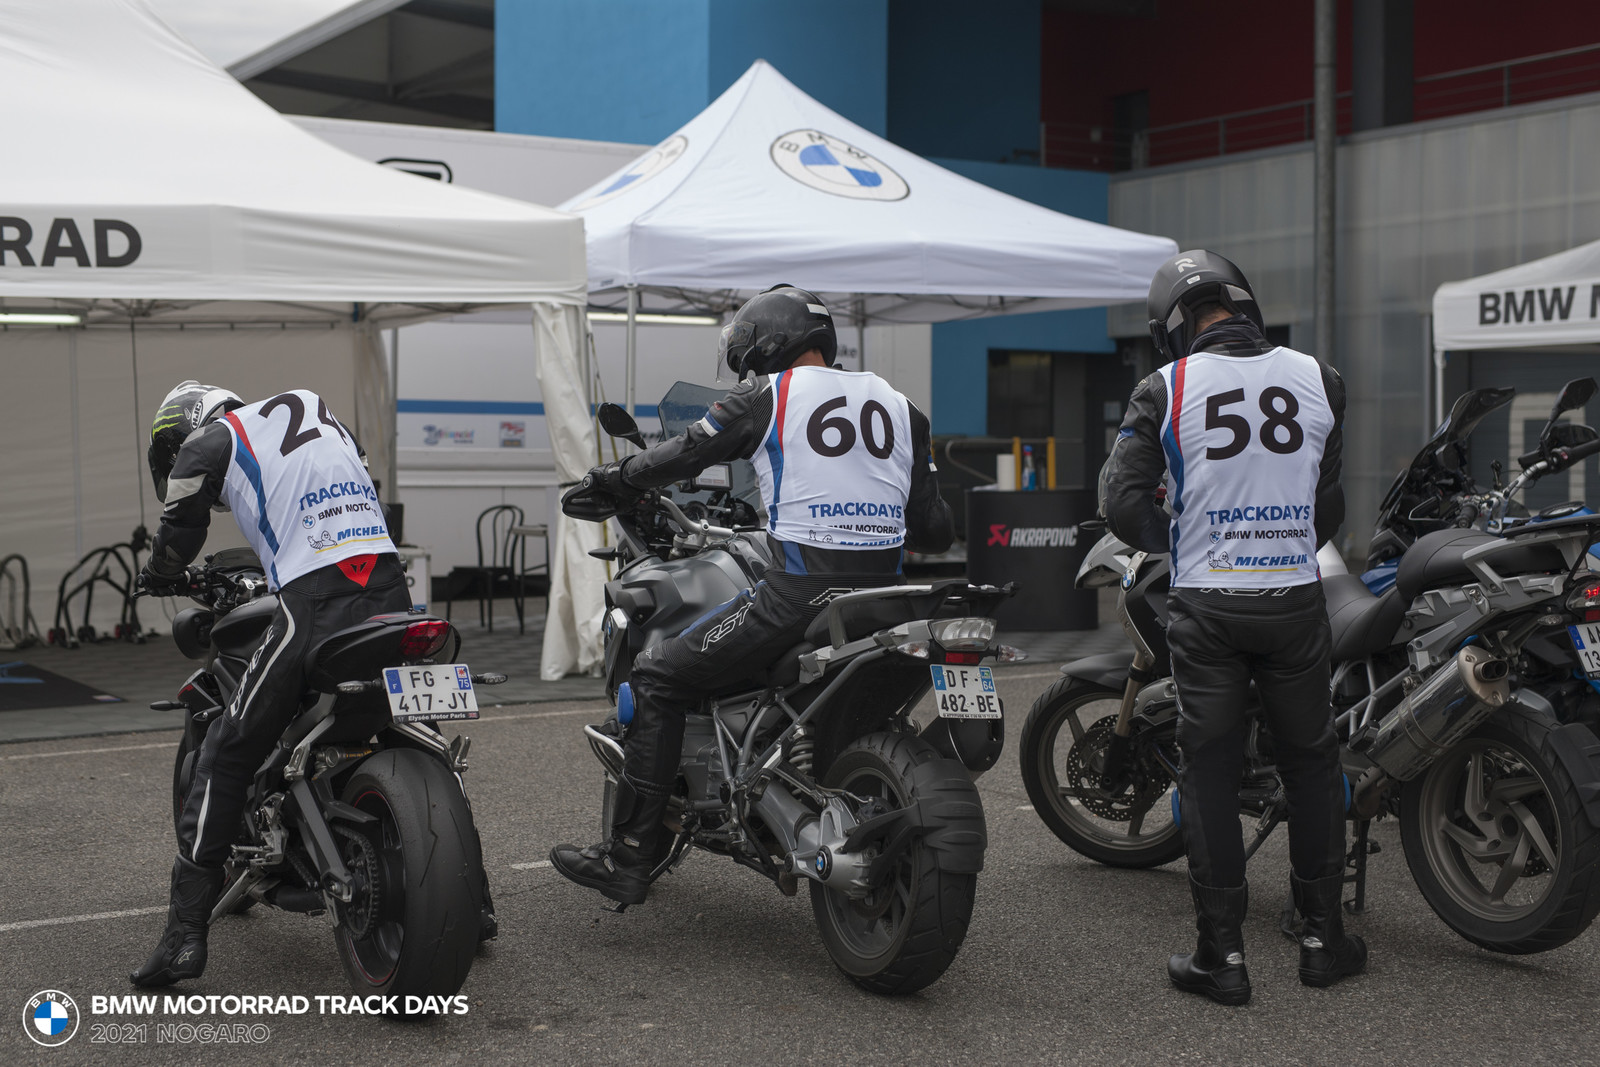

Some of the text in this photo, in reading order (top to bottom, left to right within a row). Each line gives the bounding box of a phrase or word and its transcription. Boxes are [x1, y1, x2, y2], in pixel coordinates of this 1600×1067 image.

[0, 216, 142, 268] RAD
[1479, 285, 1577, 326] BMW
[806, 395, 895, 460] 60
[1205, 386, 1304, 461] 58
[299, 481, 377, 511] TRACKDYS
[317, 506, 343, 521] BMW
[808, 502, 903, 519] TRACKDAYS
[1206, 505, 1310, 525] TRACKDAYS
[337, 525, 386, 541] MICHEL
[1224, 530, 1251, 540] BMW
[1234, 554, 1308, 567] MICHELIN
[701, 602, 754, 652] RST
[458, 679, 470, 688] 75
[982, 680, 994, 690] 64
